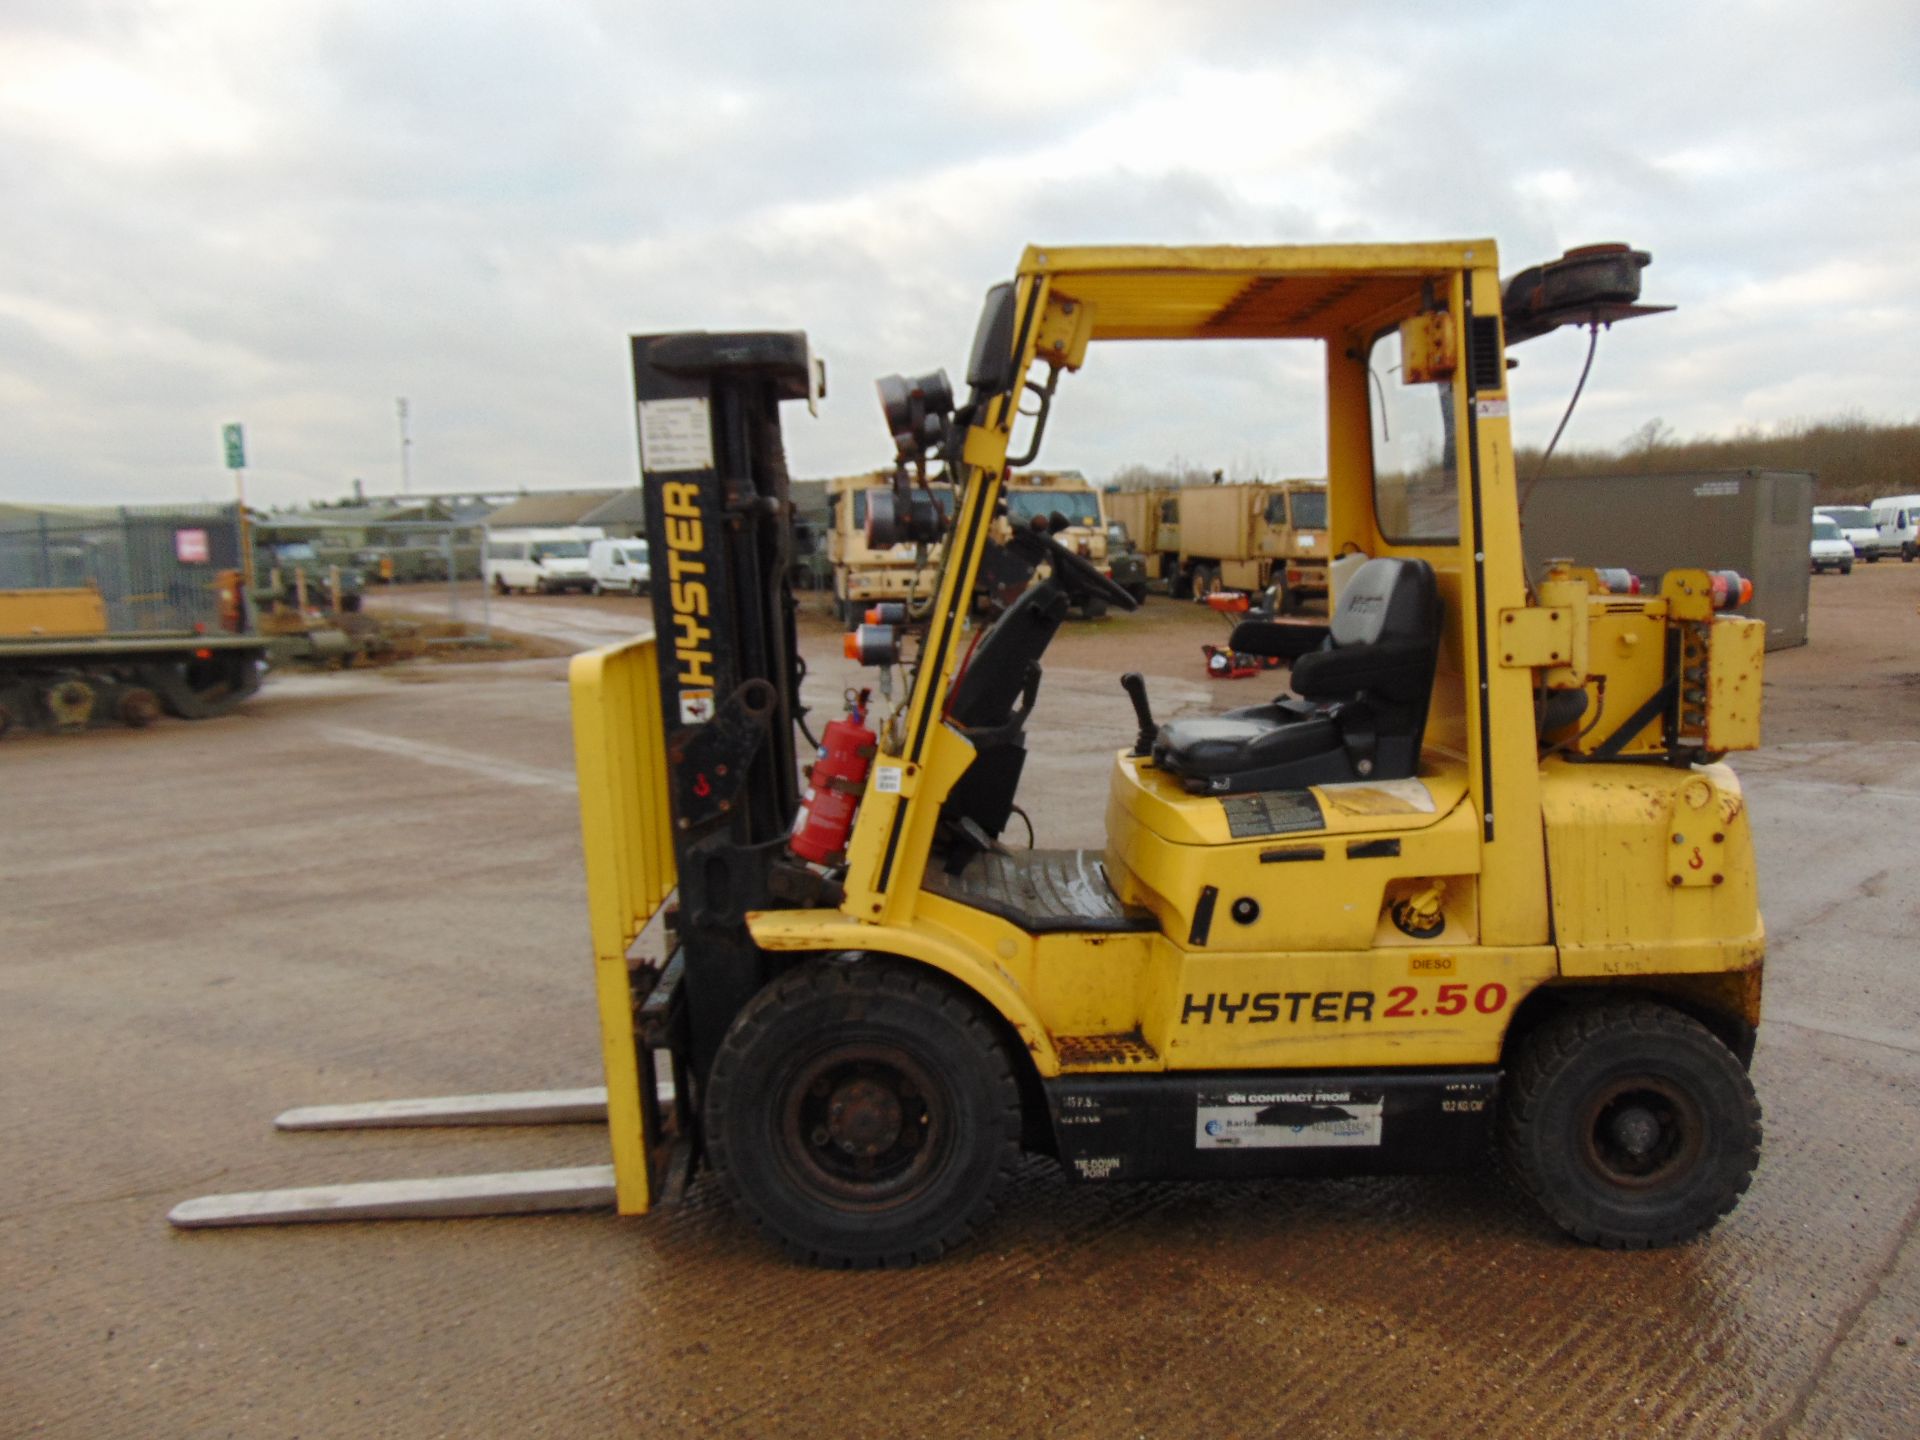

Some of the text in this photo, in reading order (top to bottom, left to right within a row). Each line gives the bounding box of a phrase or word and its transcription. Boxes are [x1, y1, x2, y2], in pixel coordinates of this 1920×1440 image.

[662, 481, 715, 687] HYSTER
[1412, 959, 1452, 970] DIESO
[1181, 983, 1508, 1025] HYSTER 2.50
[1227, 1091, 1350, 1104] ON CONTRACT FROM
